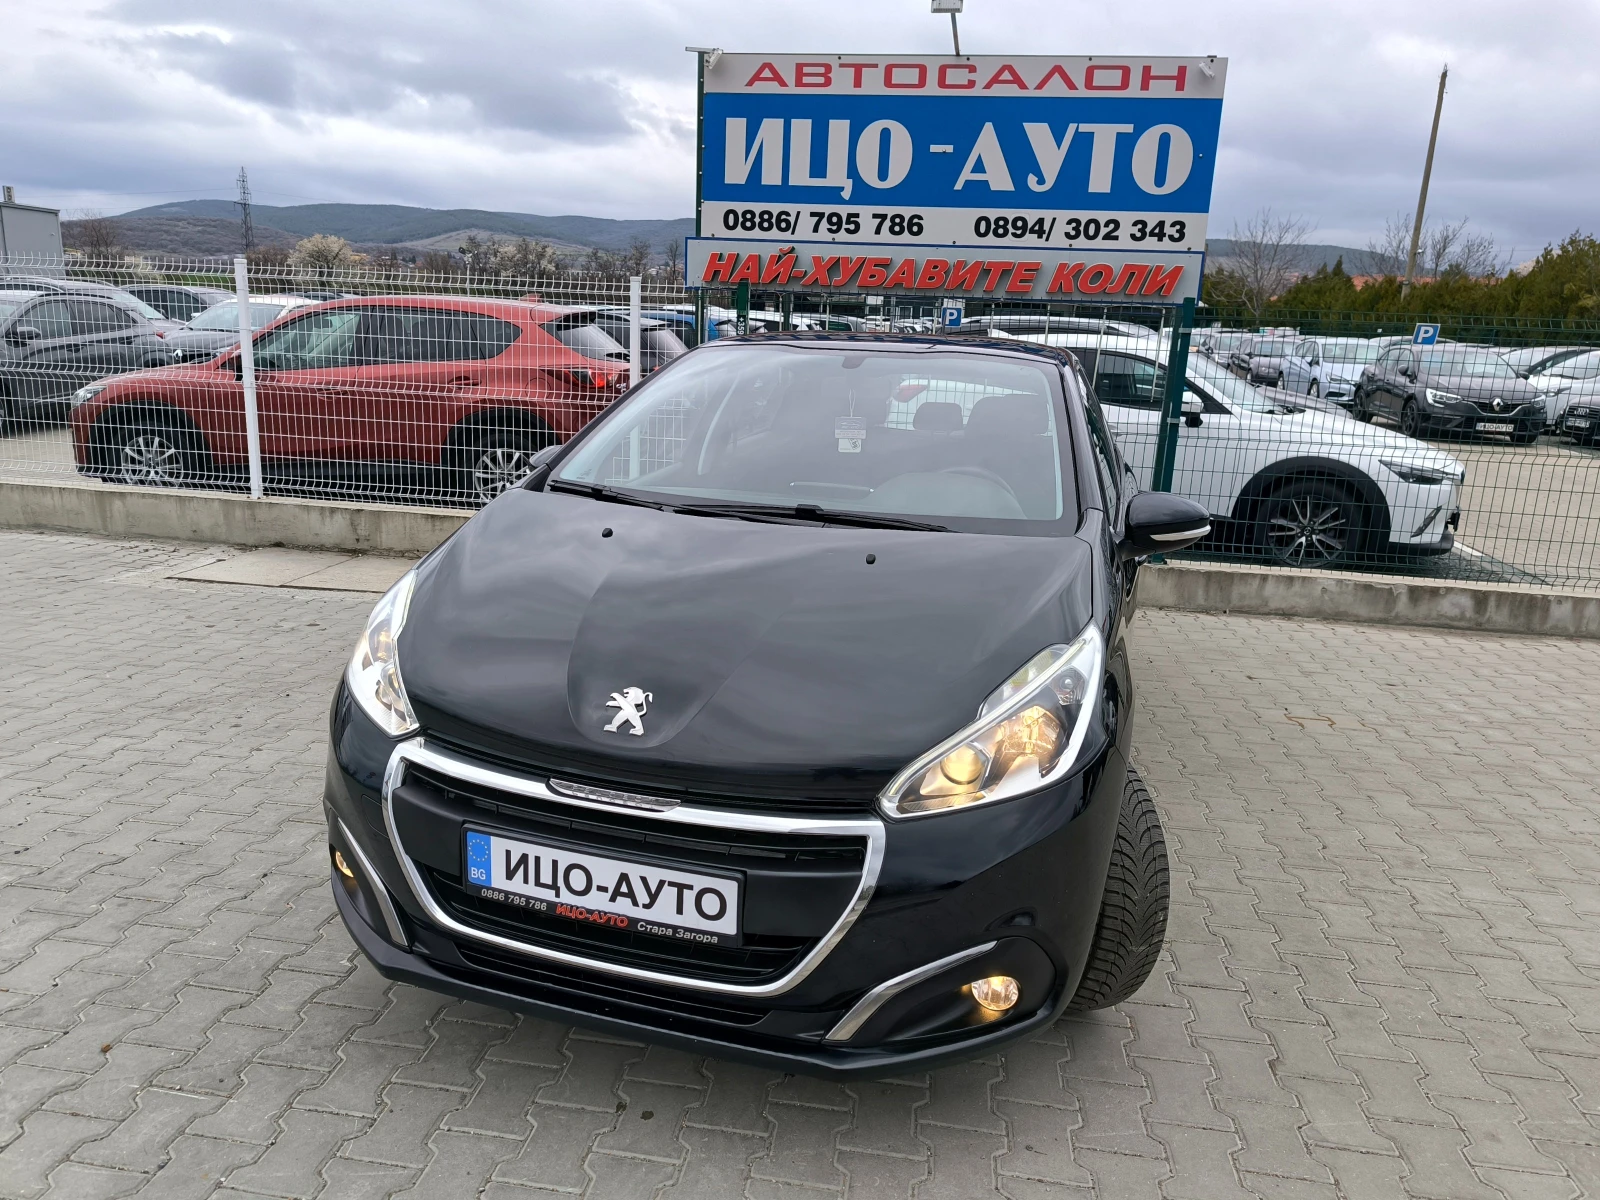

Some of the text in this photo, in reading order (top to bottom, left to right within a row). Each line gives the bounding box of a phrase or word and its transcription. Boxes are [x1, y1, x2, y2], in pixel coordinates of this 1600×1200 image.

[745, 62, 1187, 92] АВТОСАЛОН
[809, 211, 860, 235] 795
[872, 213, 924, 236] 786
[1064, 218, 1120, 241] 302
[1129, 219, 1186, 242] 343
[702, 245, 1185, 296] НАЙ-ХУБАВИТЕ КОЛИ
[945, 309, 958, 325] P
[1416, 326, 1434, 343] P
[471, 867, 486, 880] BG
[505, 848, 728, 921] ИЦО-АУТО
[481, 888, 547, 911] 0886 795 786
[555, 903, 629, 928] ИЦО-АУТО
[637, 921, 719, 943] Стара Загора
